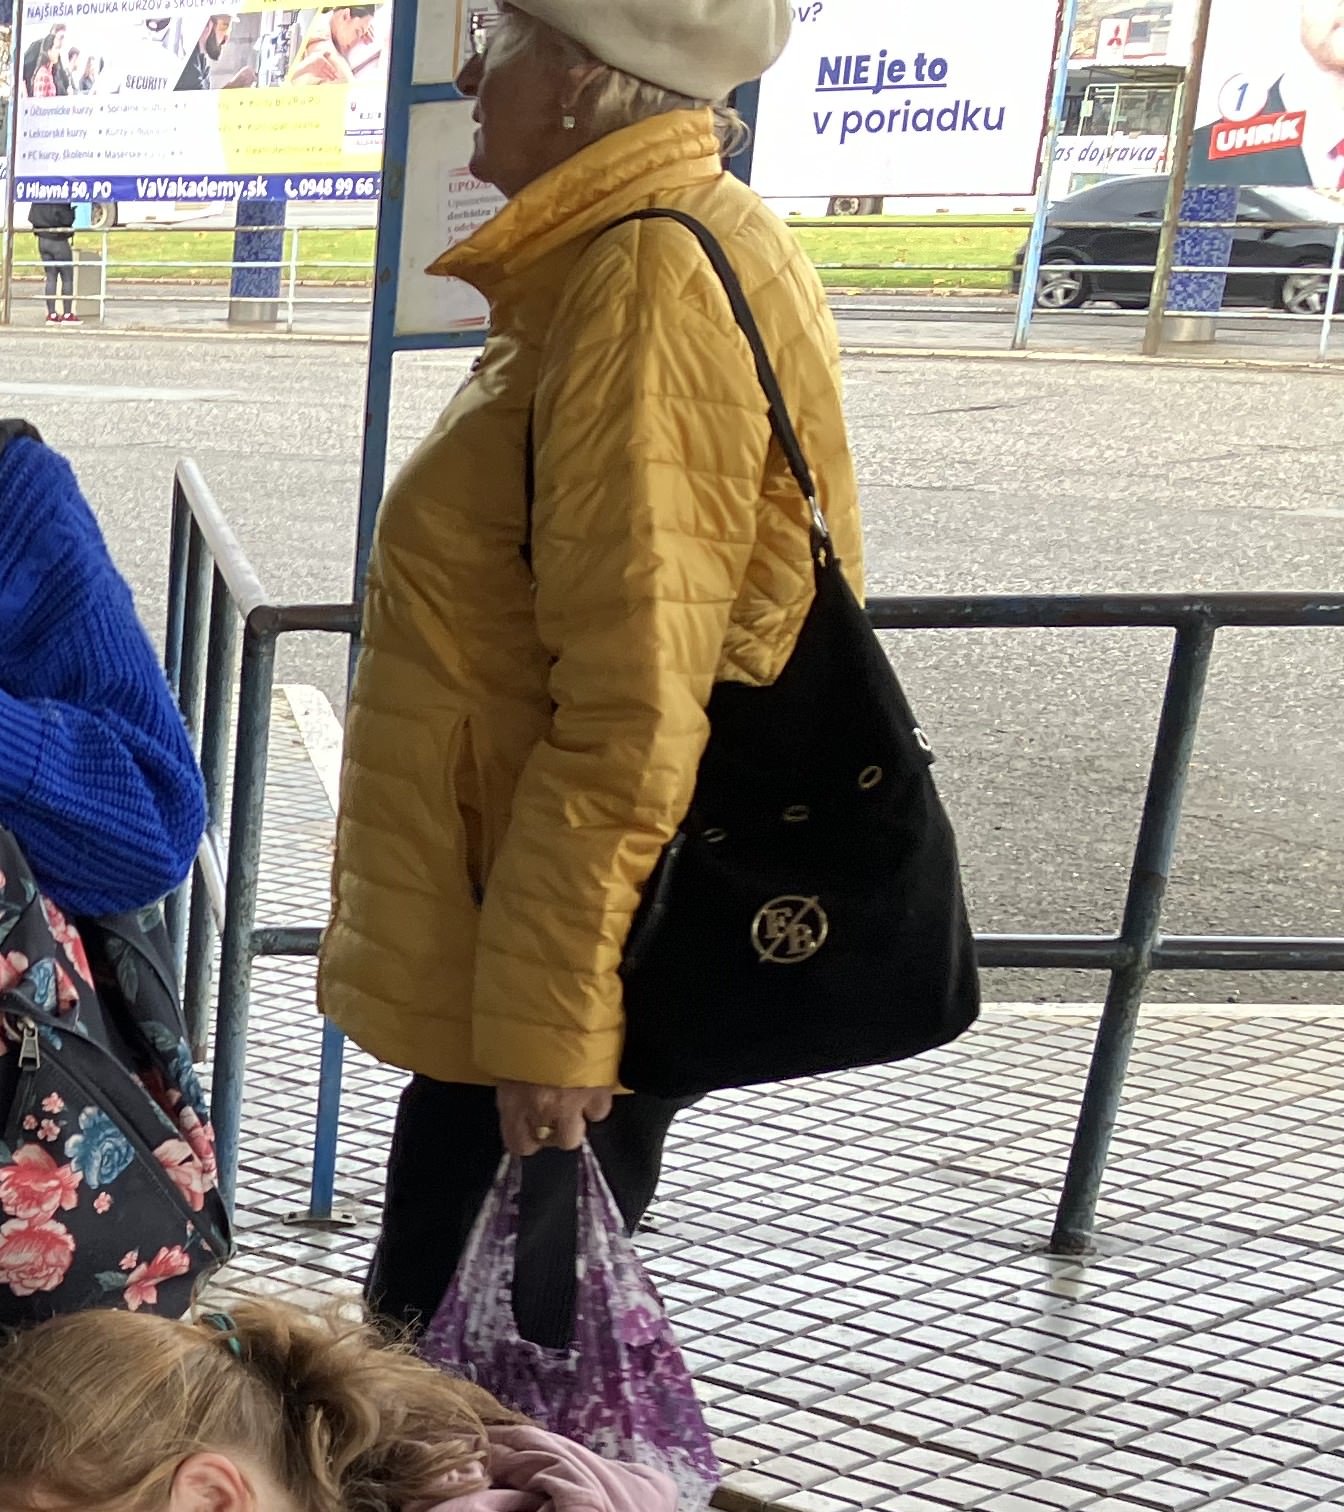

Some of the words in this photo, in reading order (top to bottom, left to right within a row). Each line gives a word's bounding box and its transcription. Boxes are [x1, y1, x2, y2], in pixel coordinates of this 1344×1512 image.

[76, 1, 118, 15] PONUKA
[125, 73, 168, 91] SECURITY
[817, 54, 872, 86] NIE
[871, 48, 907, 95] je
[913, 52, 948, 82] to
[1234, 82, 1250, 112] 1
[813, 110, 834, 135] v
[838, 99, 1006, 146] poriadku
[1216, 115, 1303, 152] UHRÍK
[26, 181, 70, 200] Hlavná
[71, 182, 90, 200] 50,
[93, 181, 112, 199] PO
[136, 175, 269, 202] VaVakademy.sk
[299, 177, 333, 197] 0948
[335, 177, 354, 196] 99
[355, 177, 375, 195] 66
